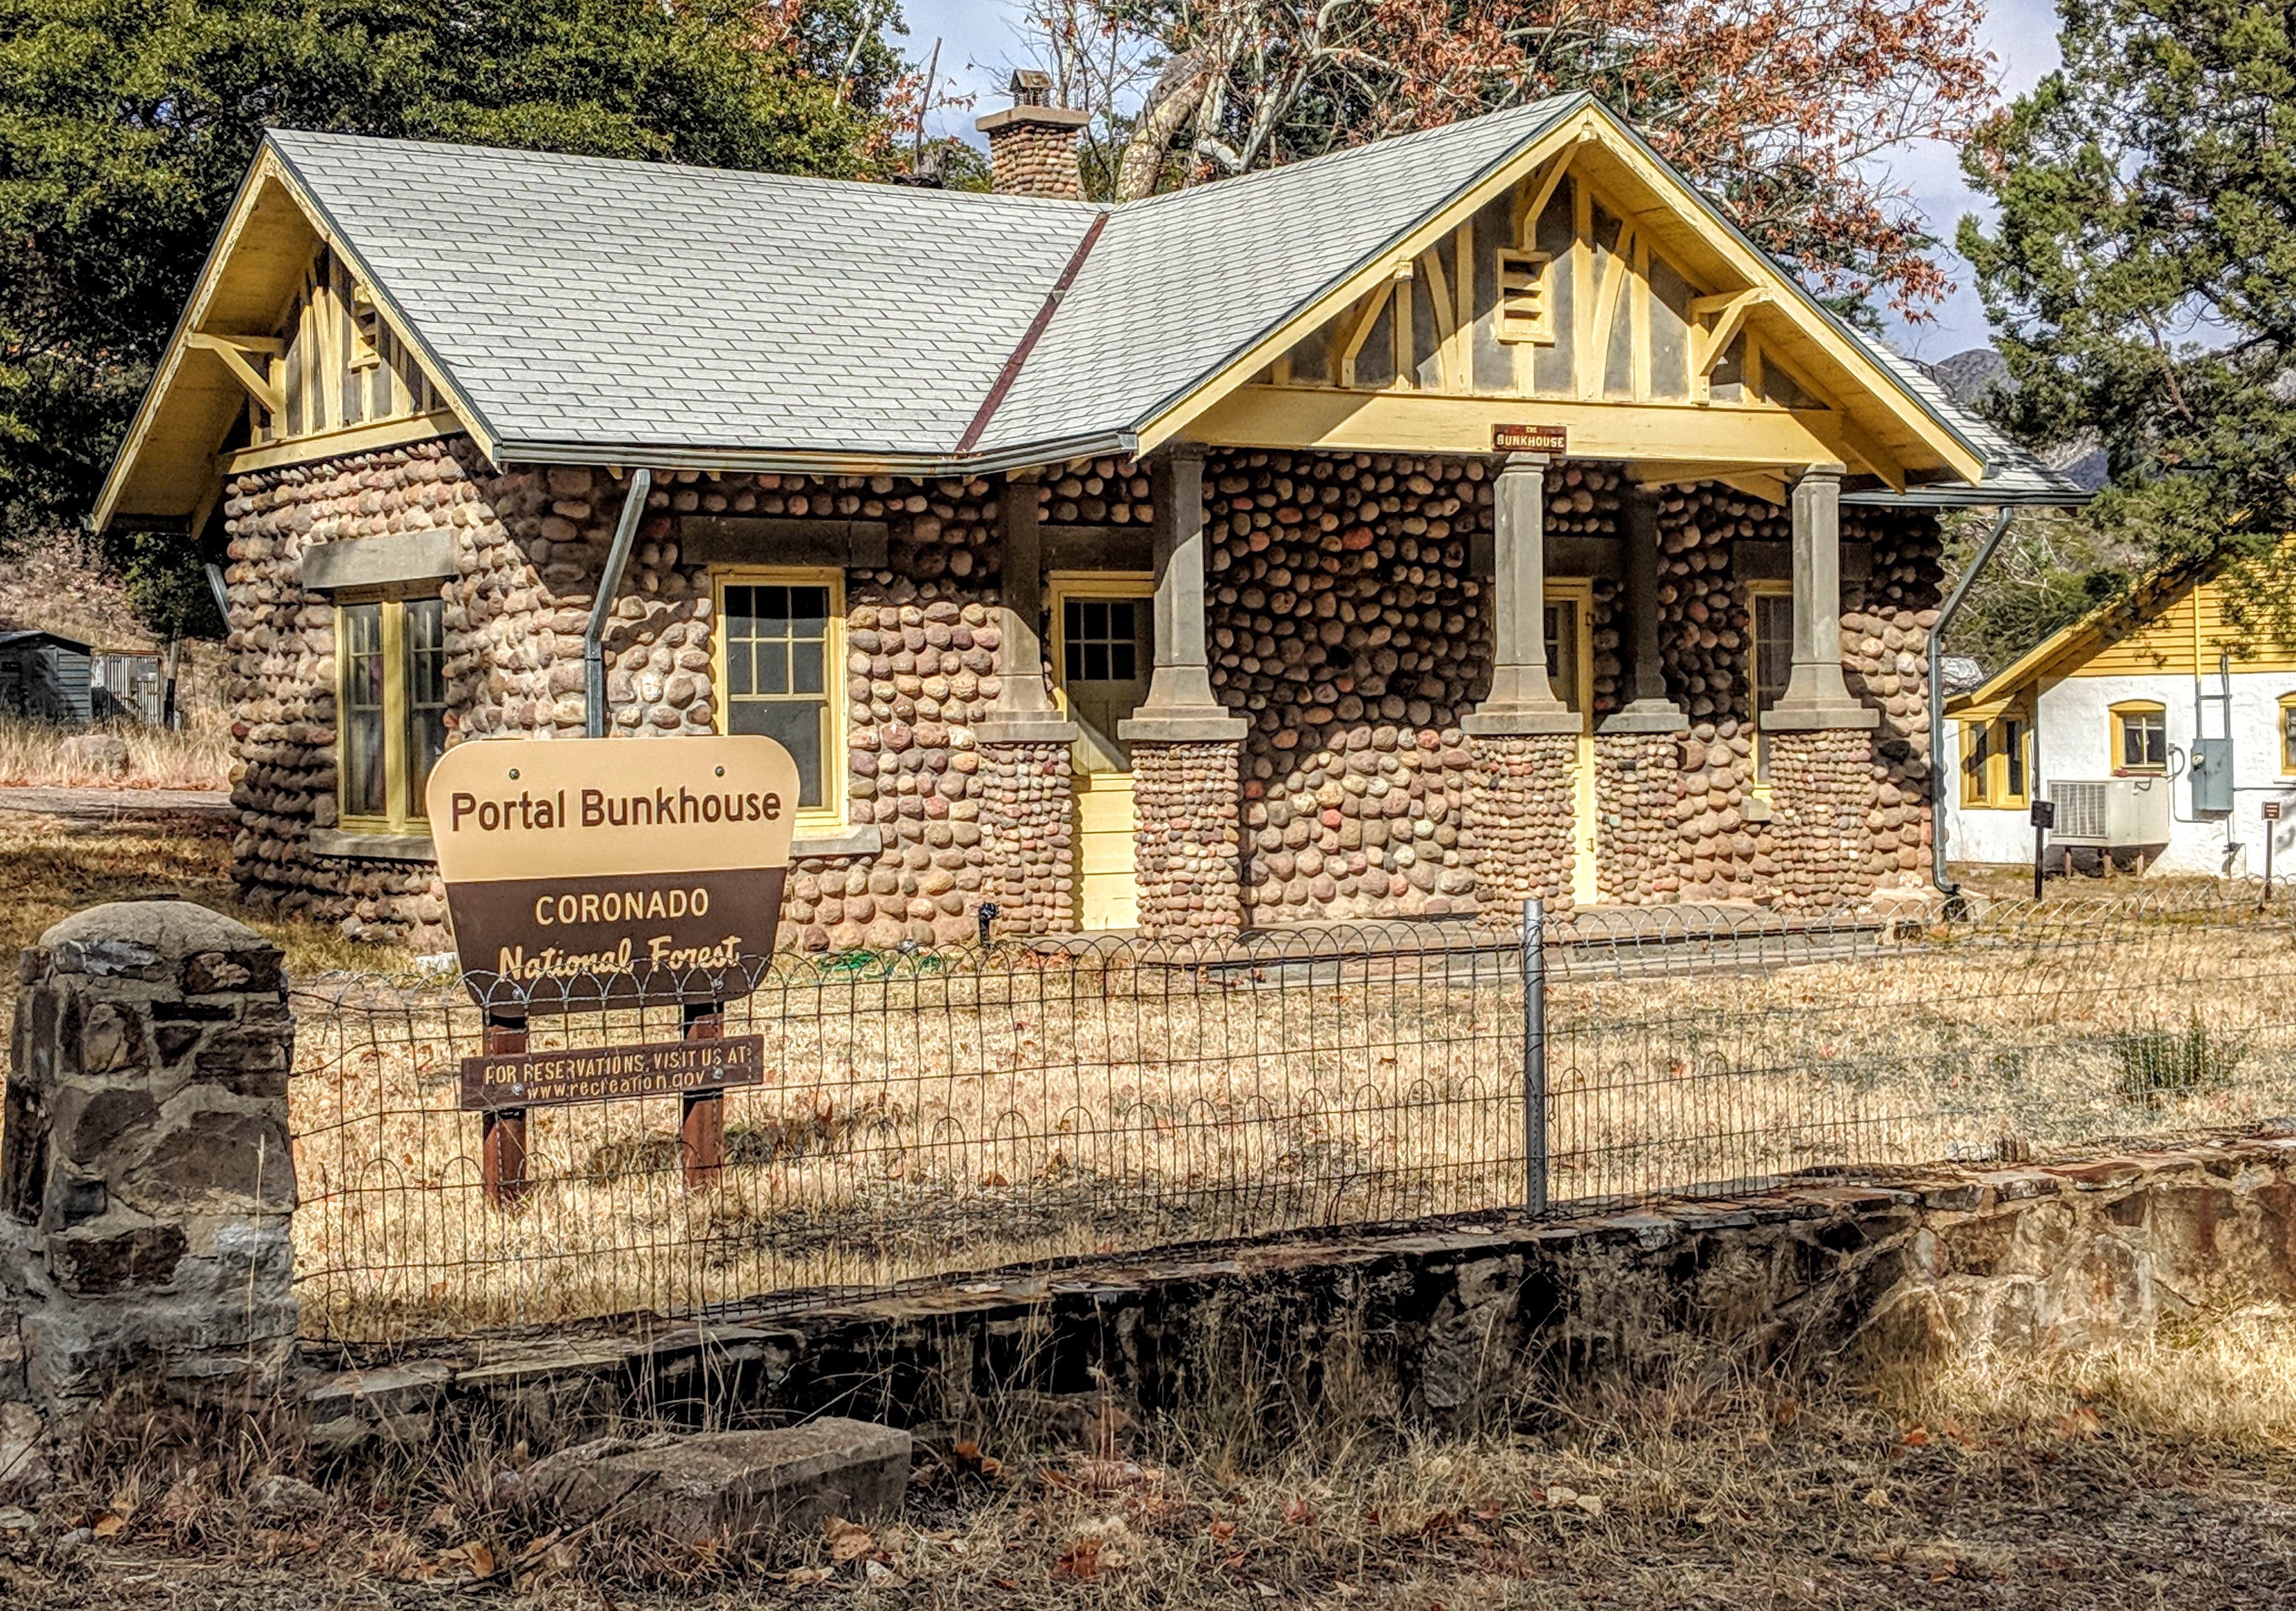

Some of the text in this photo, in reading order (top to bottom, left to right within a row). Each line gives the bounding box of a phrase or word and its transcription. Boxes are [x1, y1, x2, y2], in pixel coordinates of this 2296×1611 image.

[1496, 433, 1565, 448] BUNKHOUSE
[452, 785, 781, 831] Portal Bunkhouse
[534, 887, 710, 926] CORONADO
[499, 934, 741, 982] National Forest
[485, 1064, 517, 1085] FOR
[653, 1050, 696, 1069] VISIT
[701, 1048, 722, 1067] US
